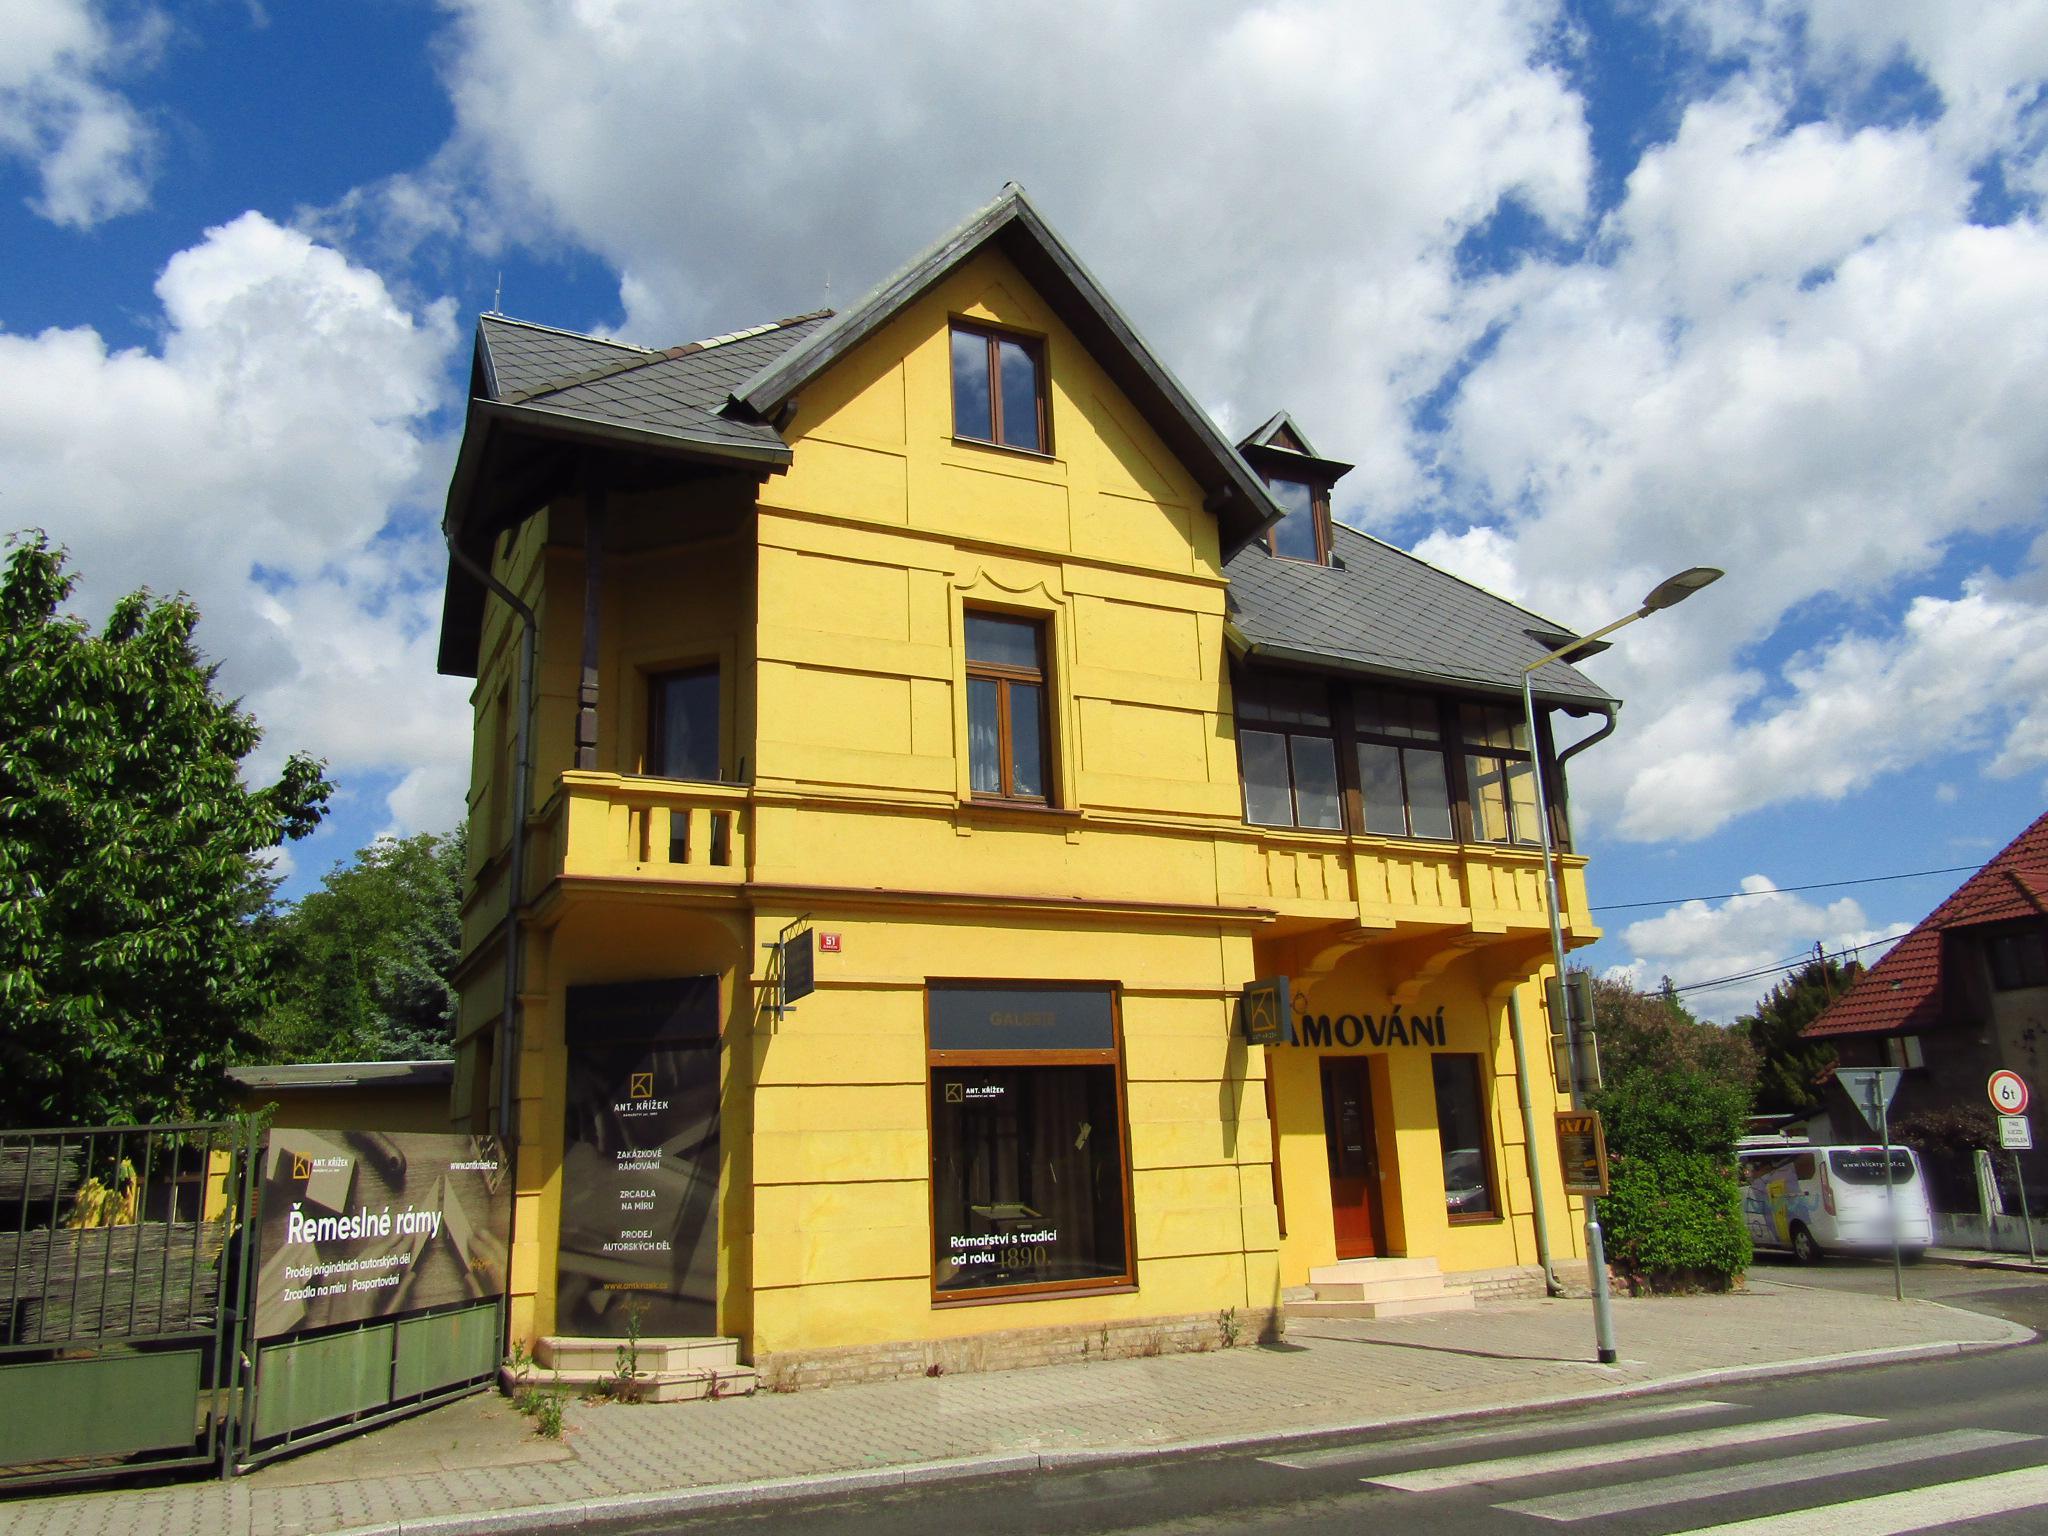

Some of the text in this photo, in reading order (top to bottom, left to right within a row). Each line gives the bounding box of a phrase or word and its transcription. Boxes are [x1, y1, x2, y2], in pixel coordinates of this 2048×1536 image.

[825, 936, 836, 945] 51
[1267, 1005, 1446, 1047] MOVÁNÍ
[982, 1086, 1005, 1094] KŘÍŽEK
[614, 1100, 669, 1112] ANT. KŘÍŽEK
[617, 1148, 663, 1159] ZAKÁZKOVÉ
[313, 1157, 349, 1167] ANT. KŘÍŽEK
[618, 1160, 660, 1171] RÁMOVÁNÍ
[620, 1190, 656, 1199] ZRCADLA
[621, 1201, 654, 1210] NA MÍRU
[287, 1202, 443, 1244] Řemeslné rámy
[621, 1230, 653, 1239] PRODEJ
[950, 1230, 1057, 1248] Rámařství s tradicí
[603, 1240, 671, 1251] AUTORSKÝCH DĚL
[951, 1253, 967, 1265] od
[970, 1252, 995, 1264] roku
[285, 1252, 411, 1279] Prodej originálních autorských děl
[283, 1274, 400, 1301] Zrcadla na míru Paspartování
